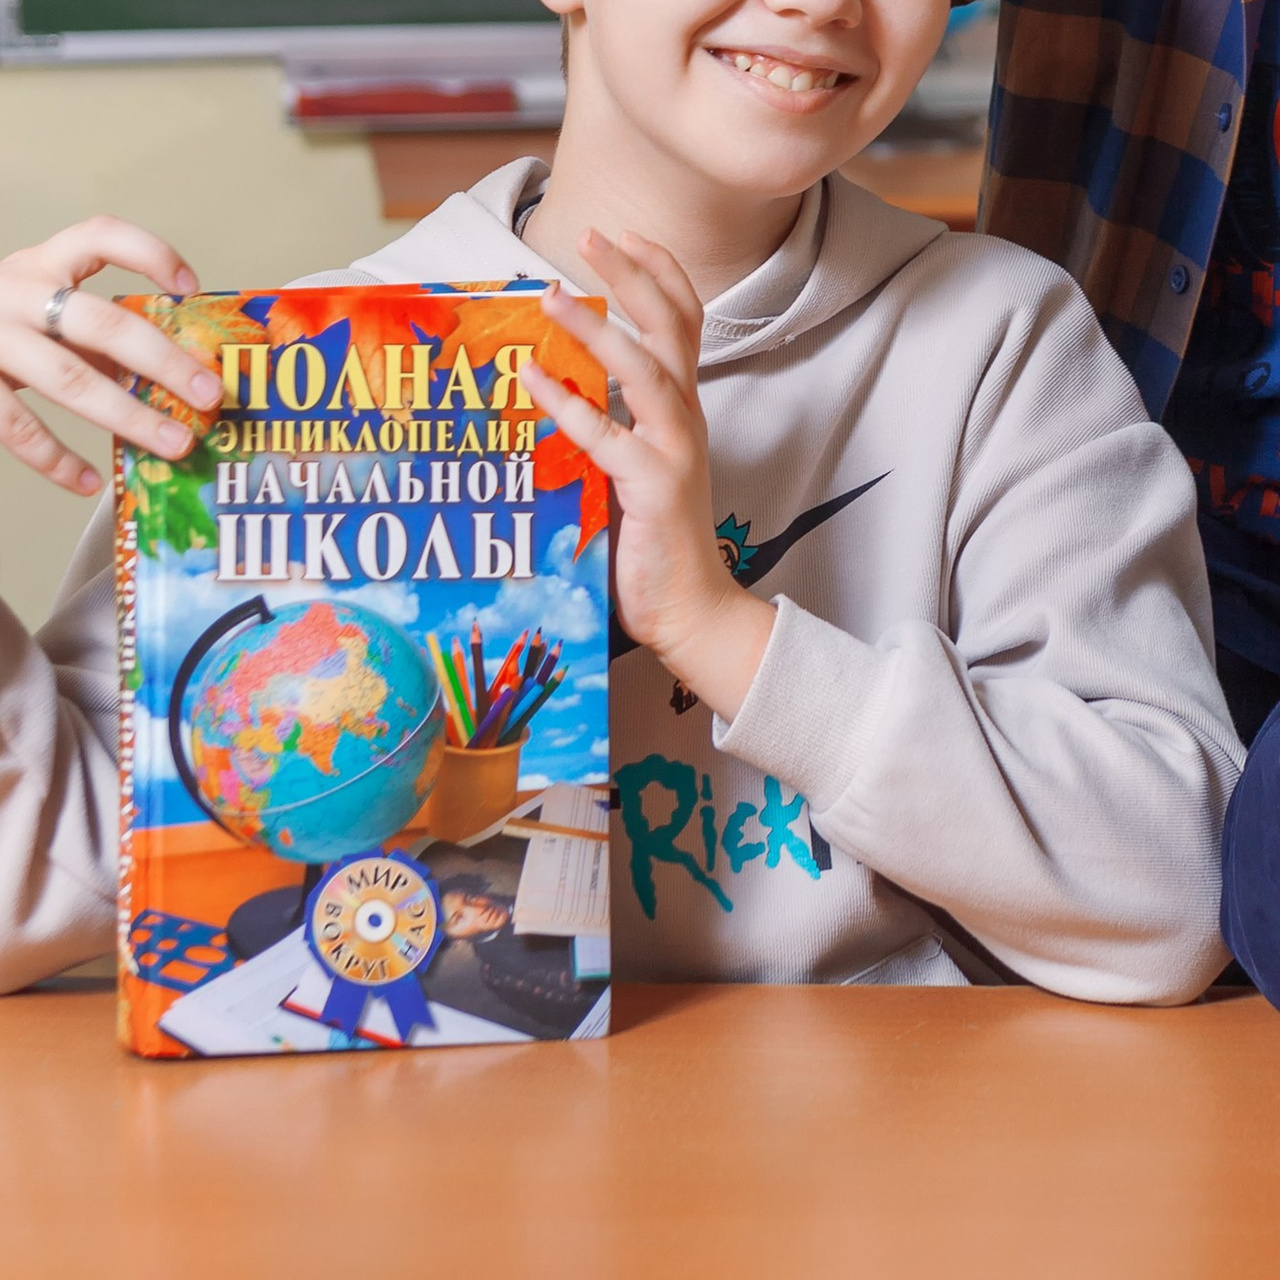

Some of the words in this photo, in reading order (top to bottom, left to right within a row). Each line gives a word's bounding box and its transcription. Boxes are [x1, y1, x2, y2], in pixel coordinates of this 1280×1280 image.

[219, 343, 537, 412] ПОЛНАЯ
[216, 420, 537, 457] ЭНЦИКЛОПЕДИЯ
[216, 453, 536, 505] НАЧАЛЬНОЙ
[216, 512, 536, 582] ШКОЛЫ
[348, 866, 408, 894] МИР
[323, 902, 388, 980] ВОКРУГ
[399, 901, 427, 962] НАС
